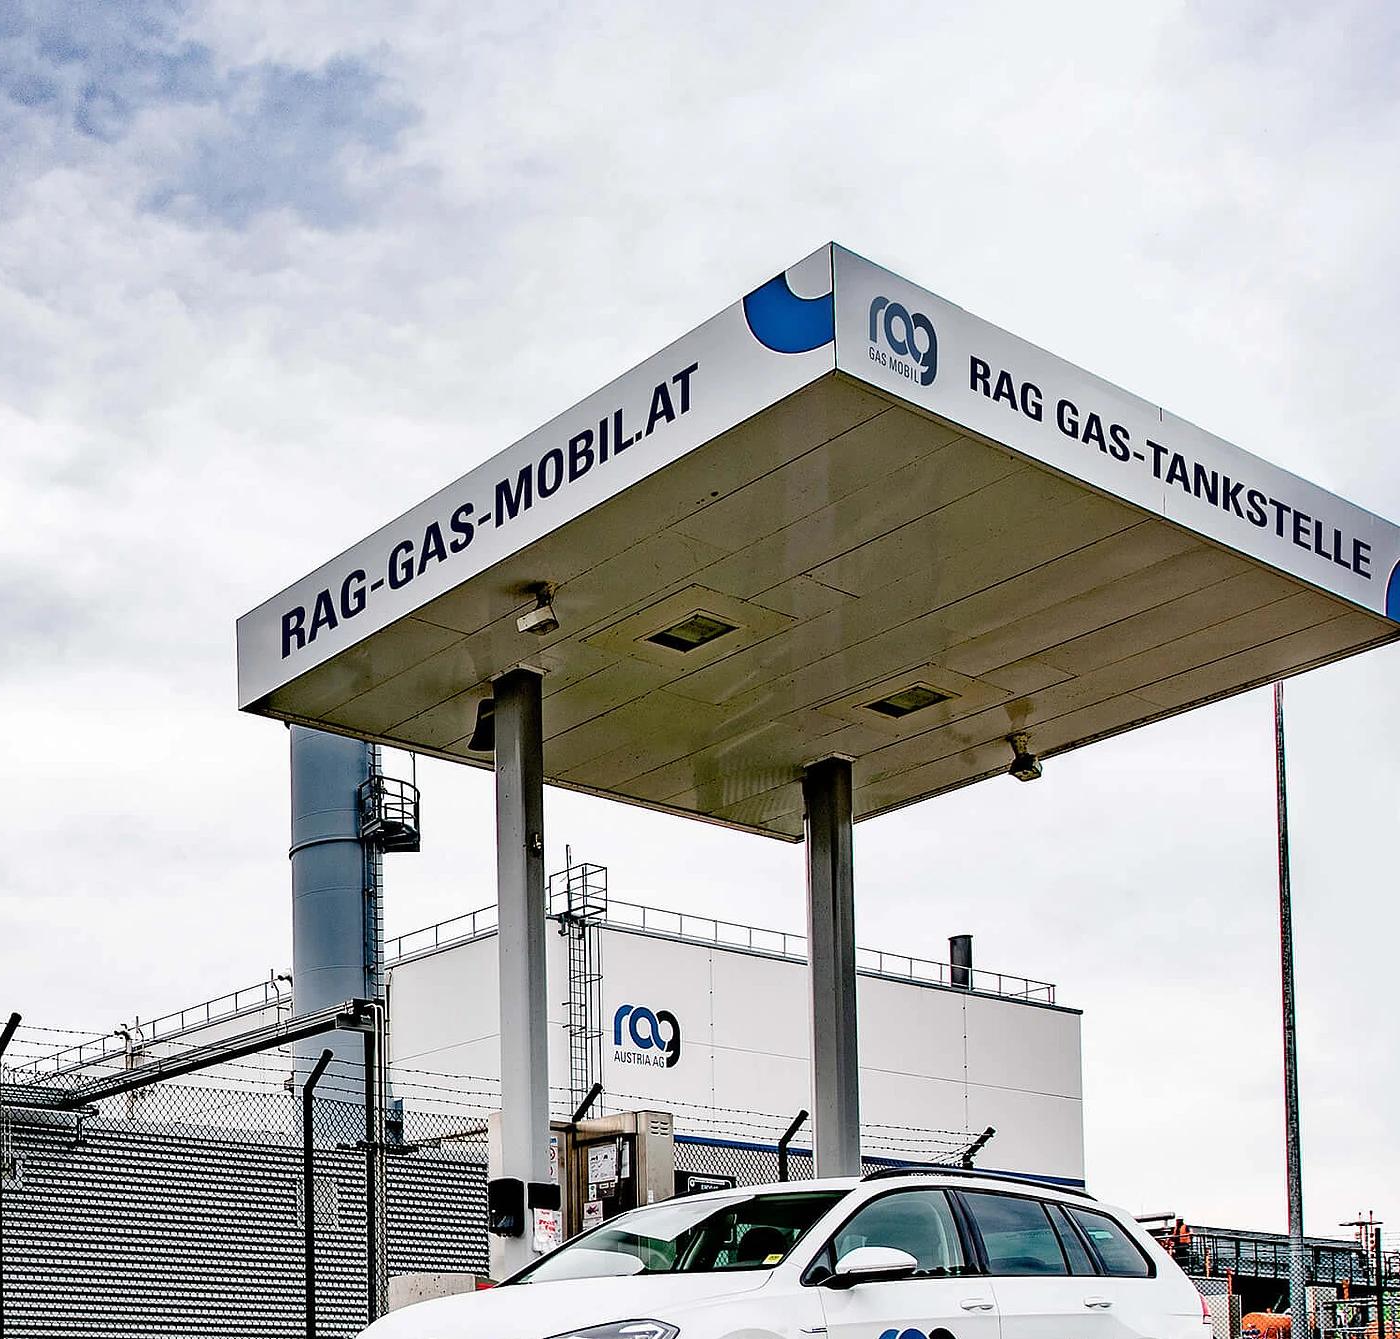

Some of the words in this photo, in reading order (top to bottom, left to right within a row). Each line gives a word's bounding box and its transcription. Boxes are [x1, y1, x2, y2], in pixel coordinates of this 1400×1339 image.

[868, 346, 887, 366] GAS
[890, 356, 919, 384] MOBIL
[281, 362, 699, 660] RAG-GAS-MOBIL.AT
[969, 356, 1043, 423] RAG
[1056, 399, 1372, 580] GAS-TANKSTELLE
[614, 1050, 651, 1066] AUSTRIA
[652, 1055, 665, 1068] AG
